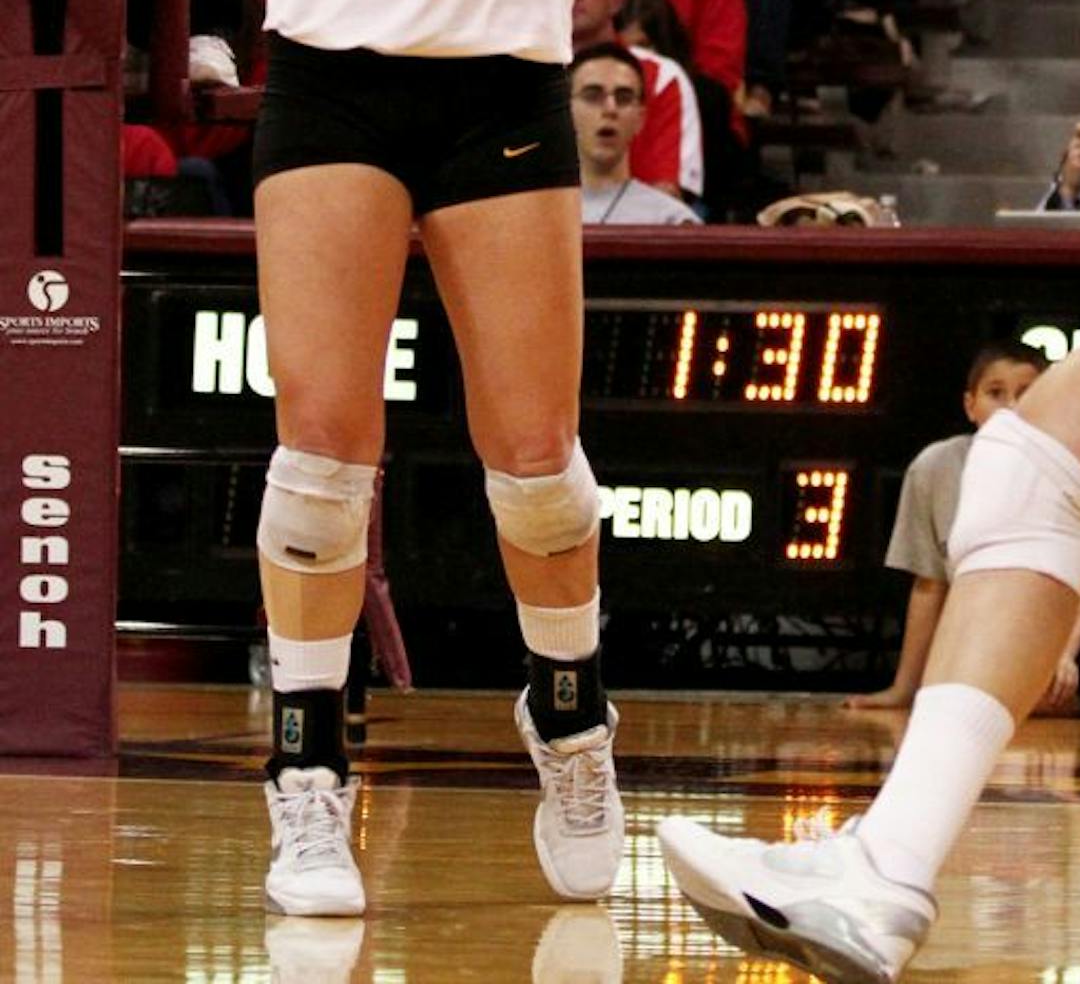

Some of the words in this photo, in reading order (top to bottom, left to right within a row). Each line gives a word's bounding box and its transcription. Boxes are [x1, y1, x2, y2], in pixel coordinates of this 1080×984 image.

[0, 316, 44, 331] SPORTS
[45, 316, 100, 332] IMPORTS
[193, 311, 418, 401] HE
[673, 311, 880, 403] 1:30
[19, 454, 71, 648] senoh
[598, 485, 752, 542] PERIOD
[786, 471, 847, 560] 3
